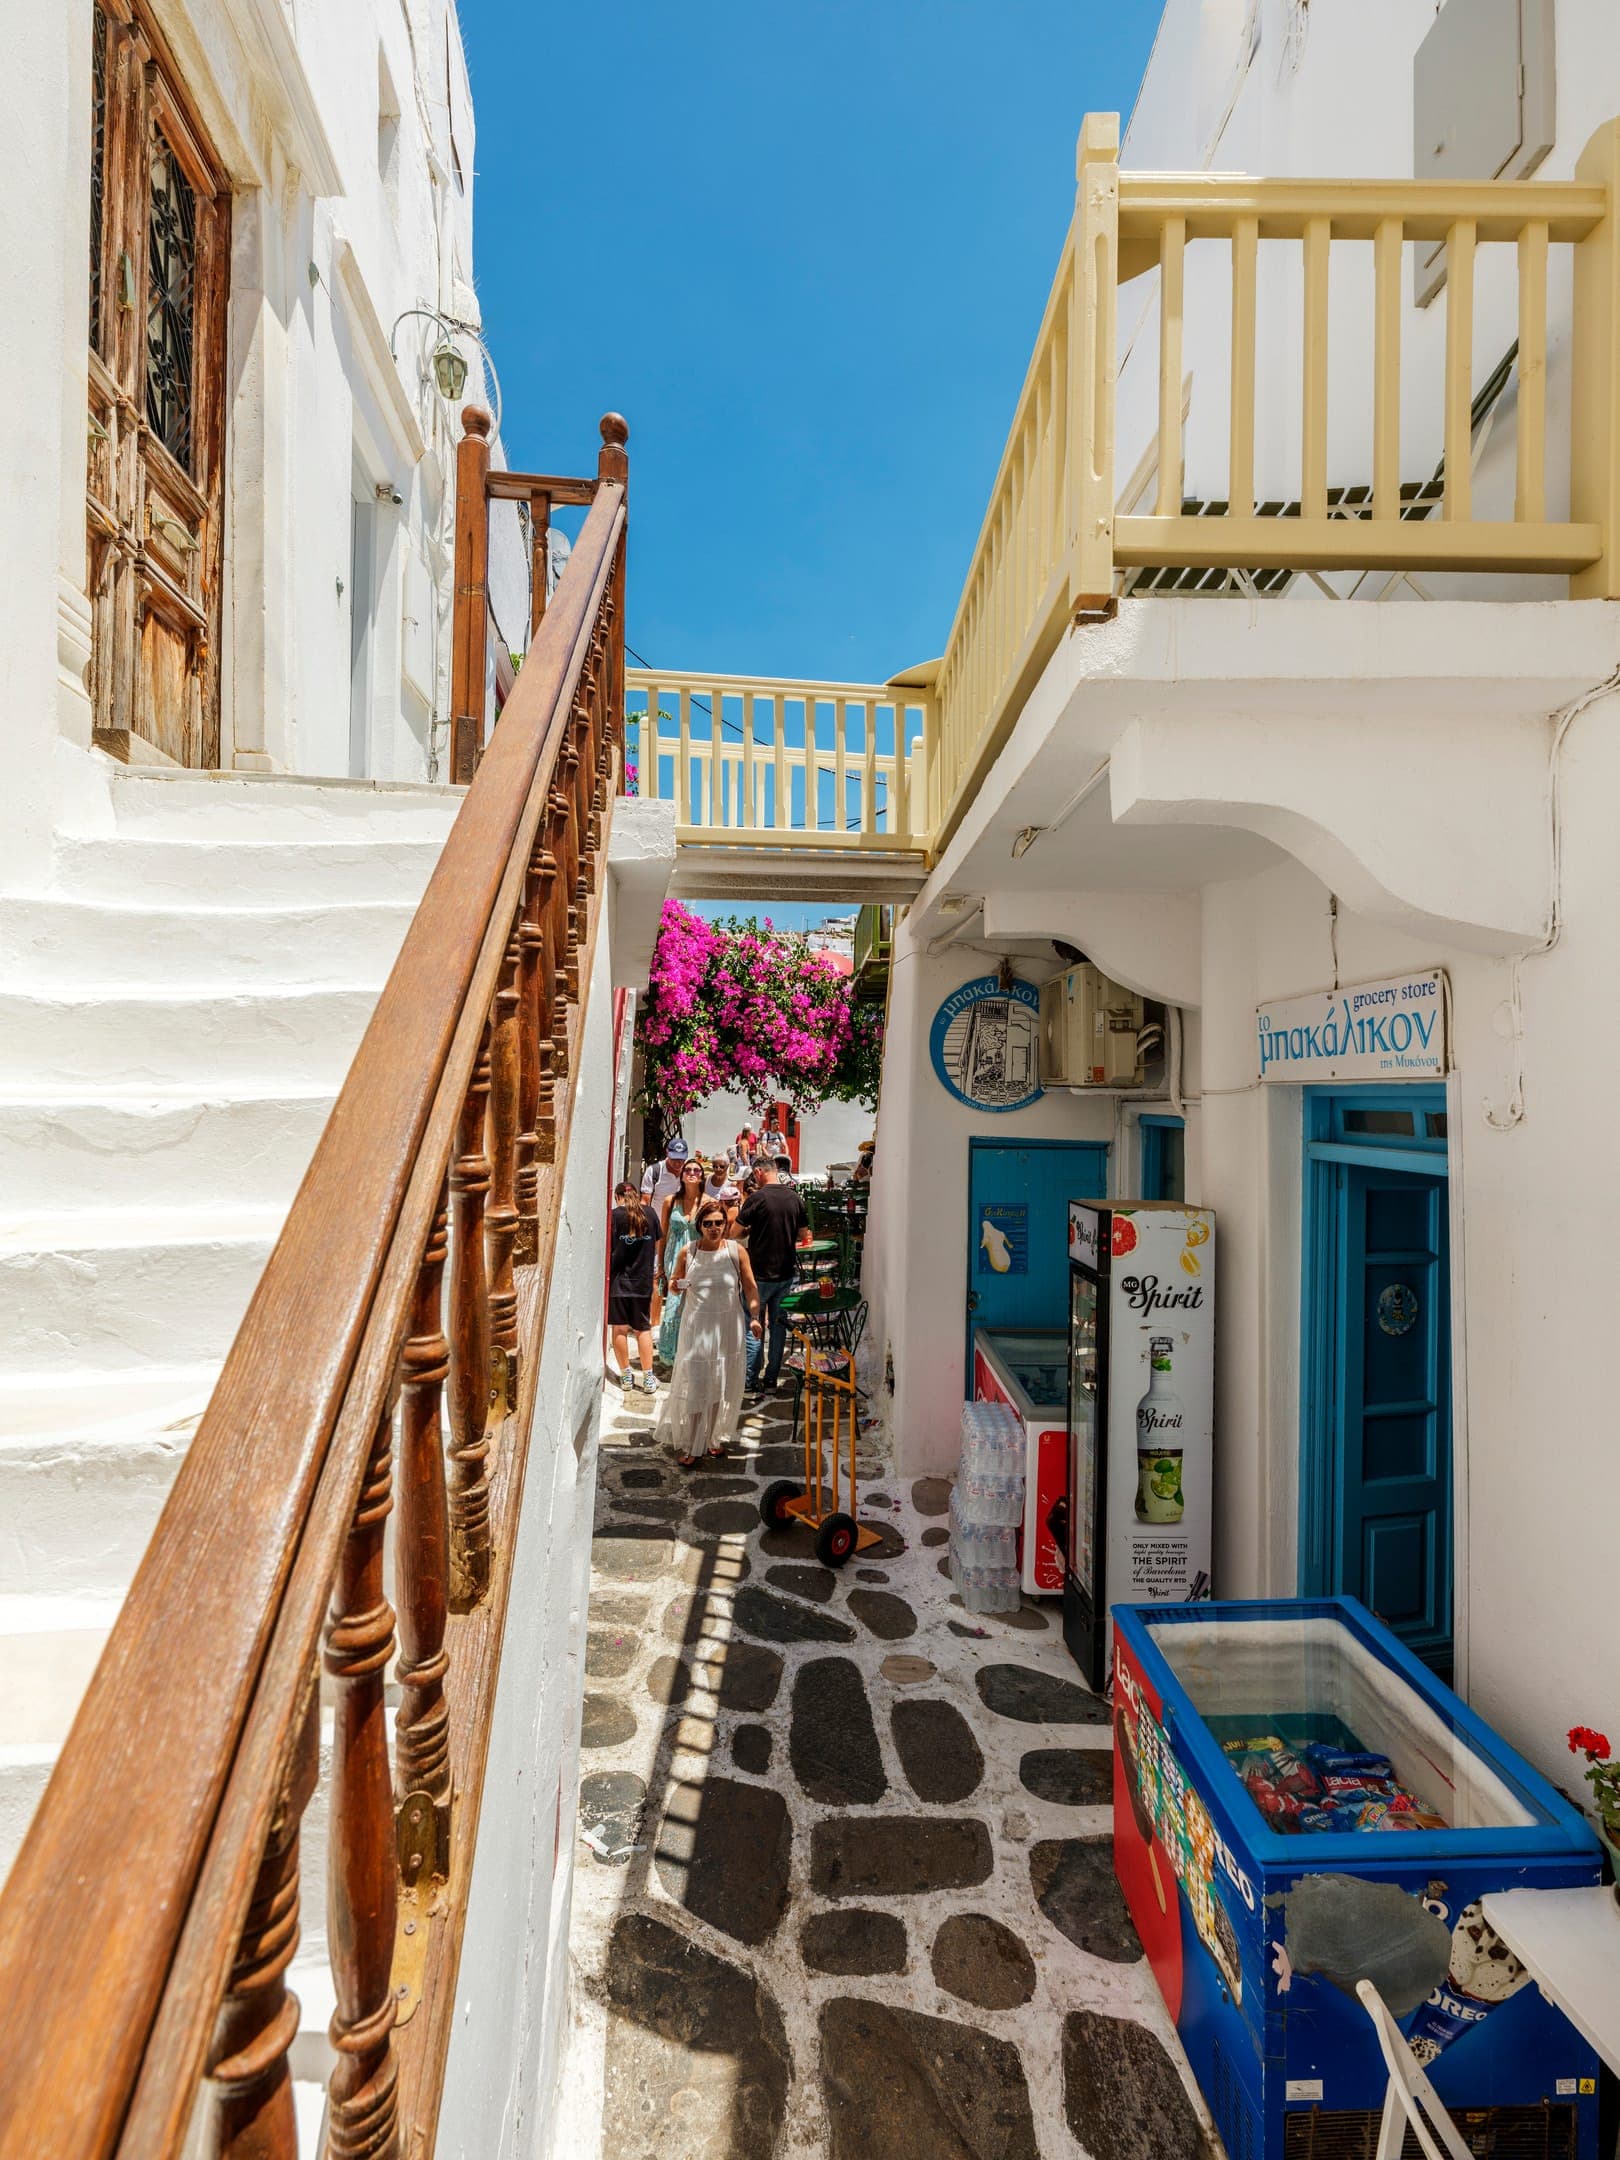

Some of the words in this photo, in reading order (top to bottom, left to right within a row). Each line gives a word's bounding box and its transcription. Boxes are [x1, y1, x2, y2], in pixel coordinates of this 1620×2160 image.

[1353, 988, 1398, 1012] grocery
[1401, 981, 1436, 1000] store
[1258, 999, 1437, 1074] μπακάλικον
[1123, 1281, 1138, 1289] MG
[1128, 1275, 1203, 1318] Spirit
[1140, 1407, 1183, 1433] Spirit
[1132, 1557, 1153, 1565] THE
[1155, 1557, 1188, 1565] SPIRIT
[1116, 1645, 1141, 1715] Lac
[1213, 1829, 1255, 1912] REO
